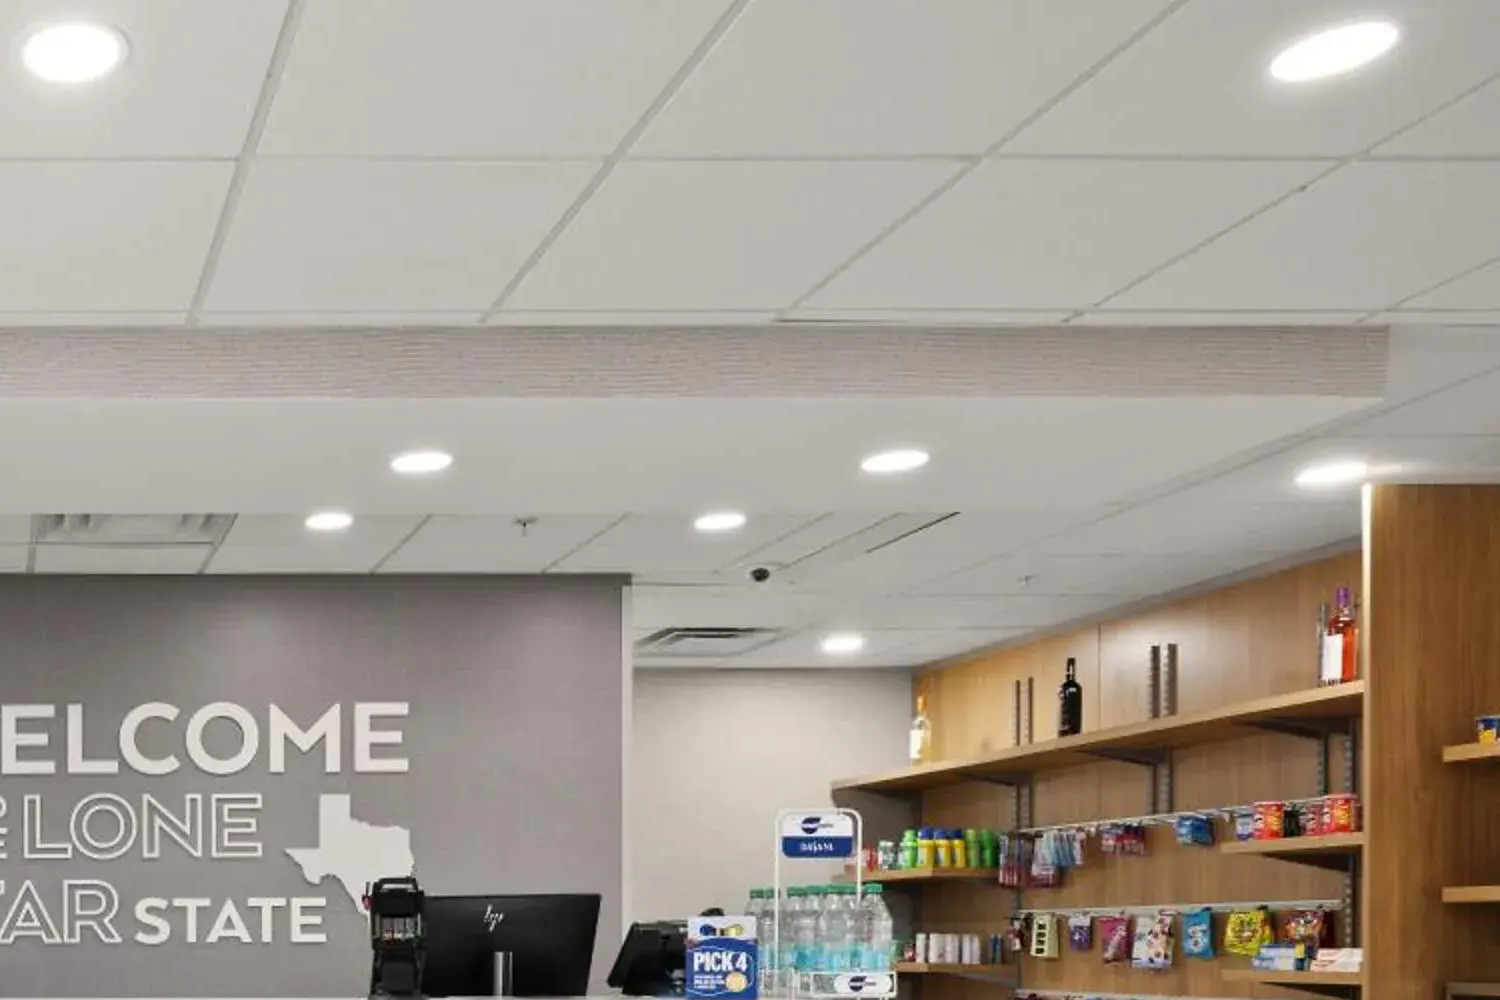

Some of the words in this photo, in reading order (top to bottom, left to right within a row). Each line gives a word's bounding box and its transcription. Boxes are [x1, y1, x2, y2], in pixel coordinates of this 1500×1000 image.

[23, 793, 262, 859] LONE
[134, 897, 327, 944] STATE
[484, 904, 504, 932] hp
[693, 951, 734, 972] PICK
[735, 951, 748, 972] 4
